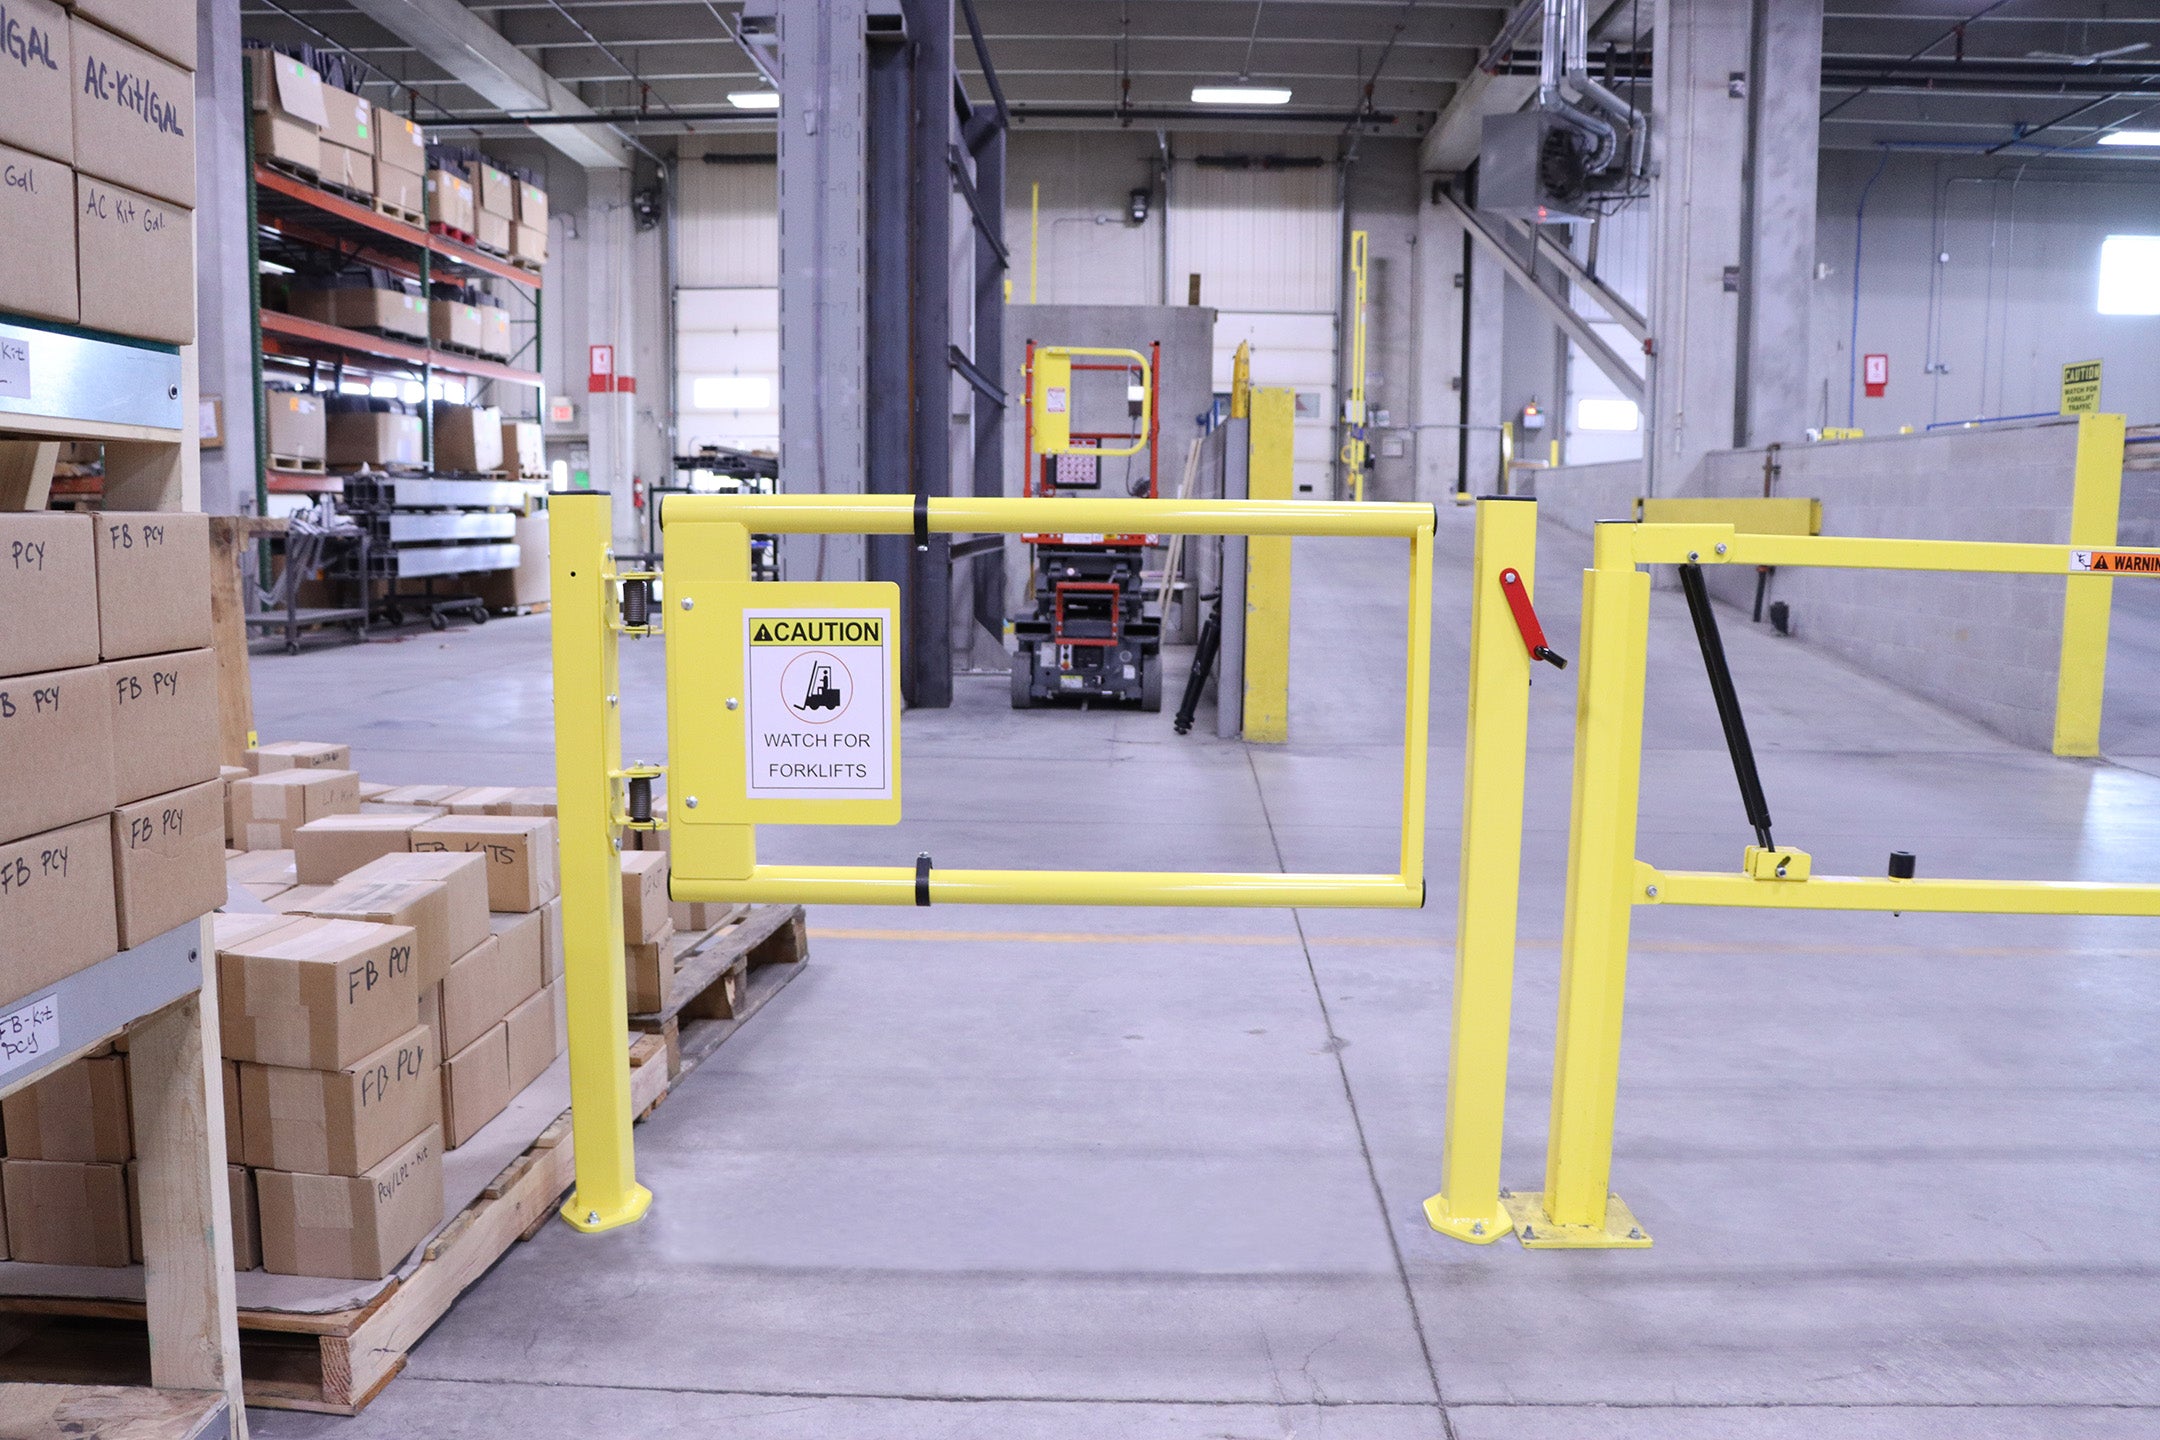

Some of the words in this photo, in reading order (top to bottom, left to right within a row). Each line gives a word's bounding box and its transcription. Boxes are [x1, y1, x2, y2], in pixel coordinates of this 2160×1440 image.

[86, 188, 108, 219] AC
[115, 200, 136, 223] Kit
[109, 523, 133, 549] FB
[143, 525, 164, 548] PCY
[12, 540, 46, 571] PCY
[774, 622, 879, 642] CAUTION
[33, 686, 60, 713] PCY
[116, 676, 142, 705] FB
[152, 671, 178, 696] PCY
[764, 733, 827, 748] WATCH
[833, 733, 871, 748] FOR
[768, 763, 867, 779] FORKLIFTS
[131, 816, 153, 849] FB
[1, 857, 31, 895] FB
[41, 846, 69, 878] PCY
[349, 960, 379, 1005] FB
[361, 1064, 388, 1108] FB
